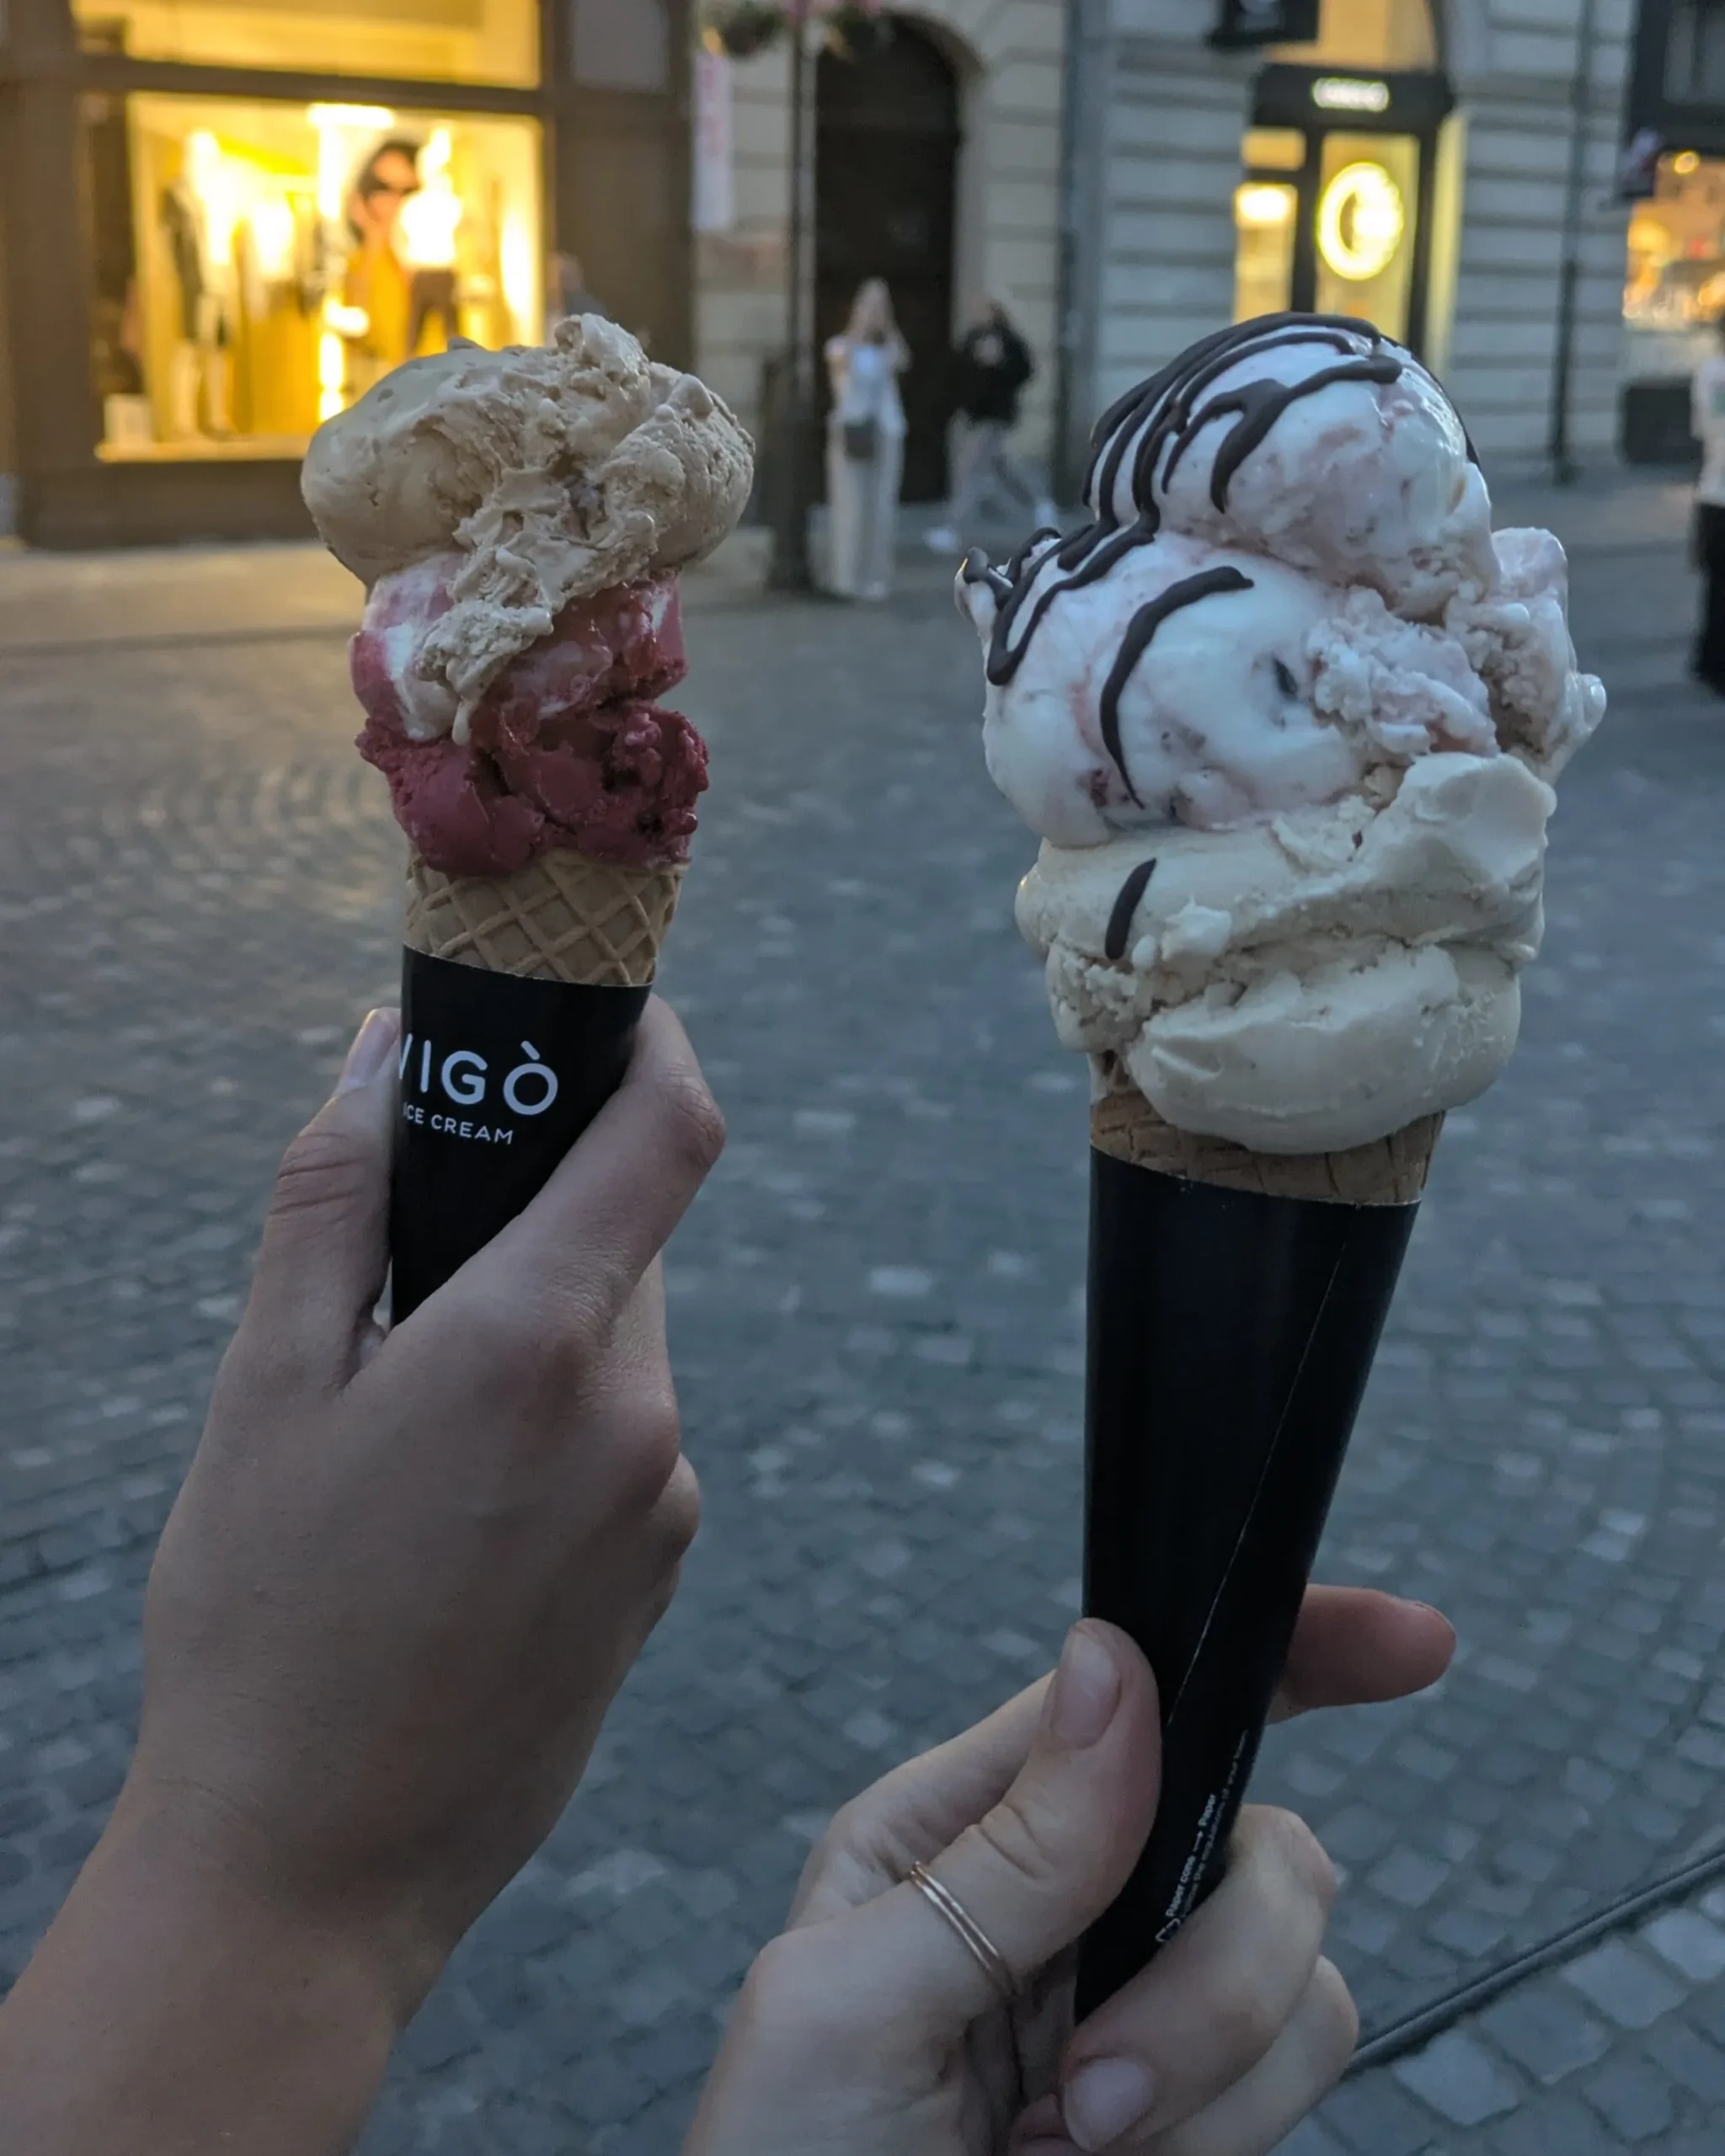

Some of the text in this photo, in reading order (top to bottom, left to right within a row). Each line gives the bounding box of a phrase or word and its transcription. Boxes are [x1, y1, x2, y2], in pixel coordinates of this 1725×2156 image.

[403, 1102, 514, 1145] ICE CREAM
[1198, 1793, 1216, 1827] Paper
